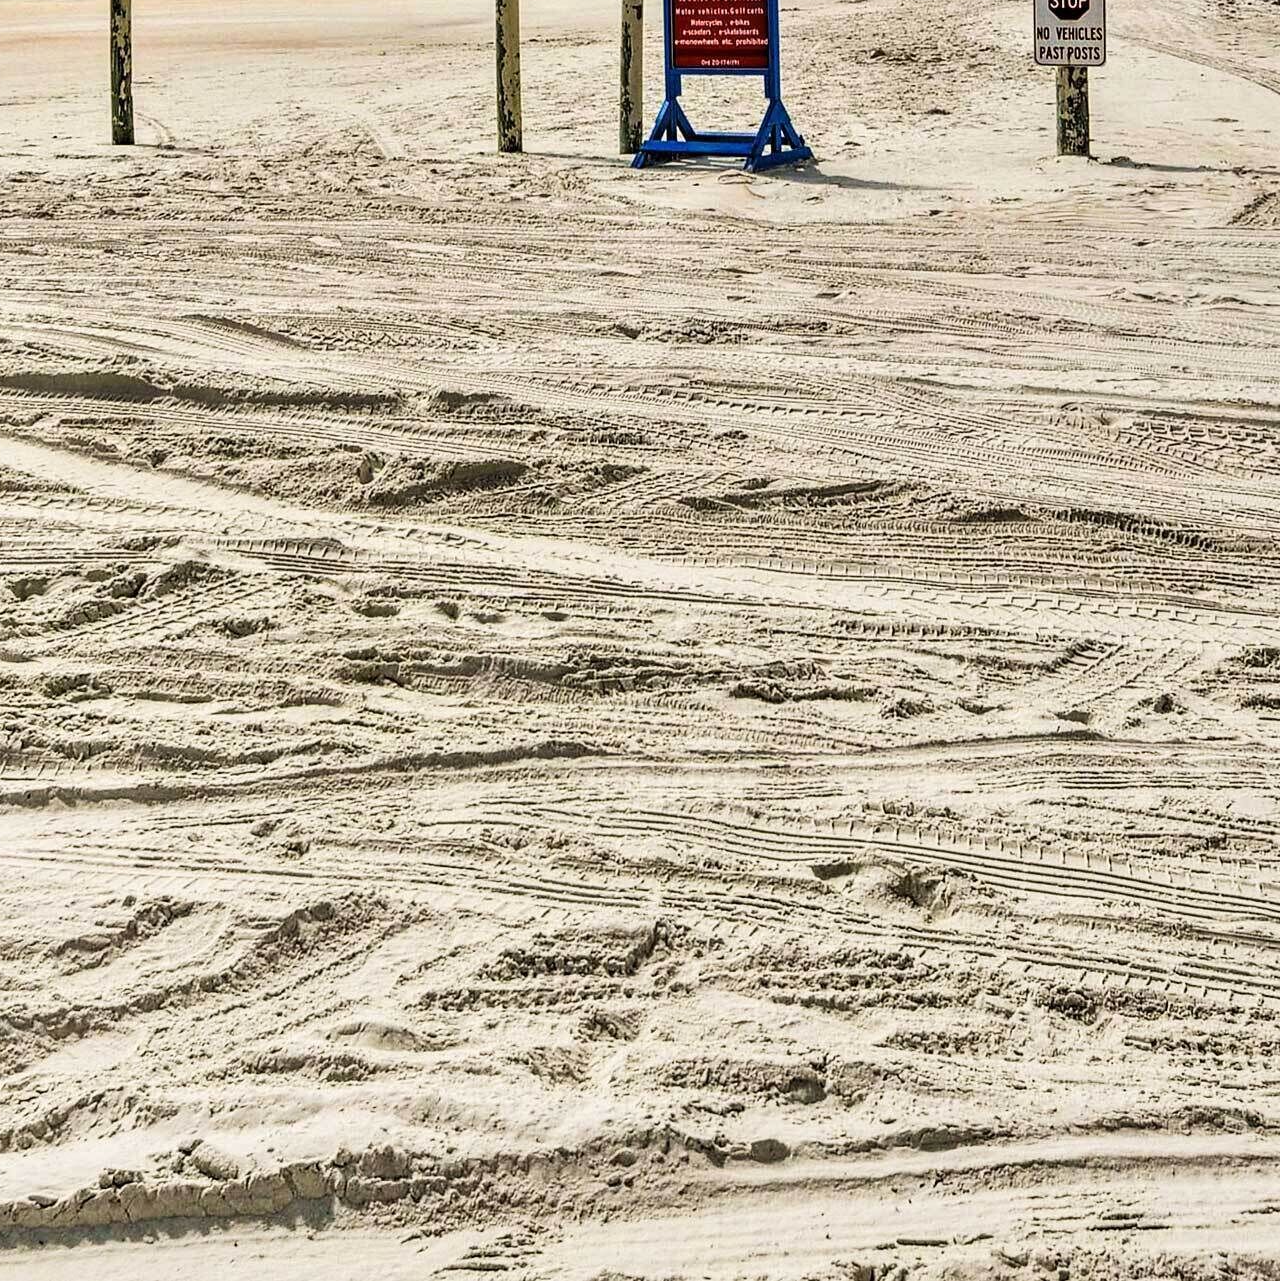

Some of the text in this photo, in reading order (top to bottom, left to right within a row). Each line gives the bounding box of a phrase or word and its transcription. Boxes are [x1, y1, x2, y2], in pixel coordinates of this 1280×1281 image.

[1036, 26, 1103, 41] NO VEHICLES
[1040, 46, 1101, 60] PAST POSTS
